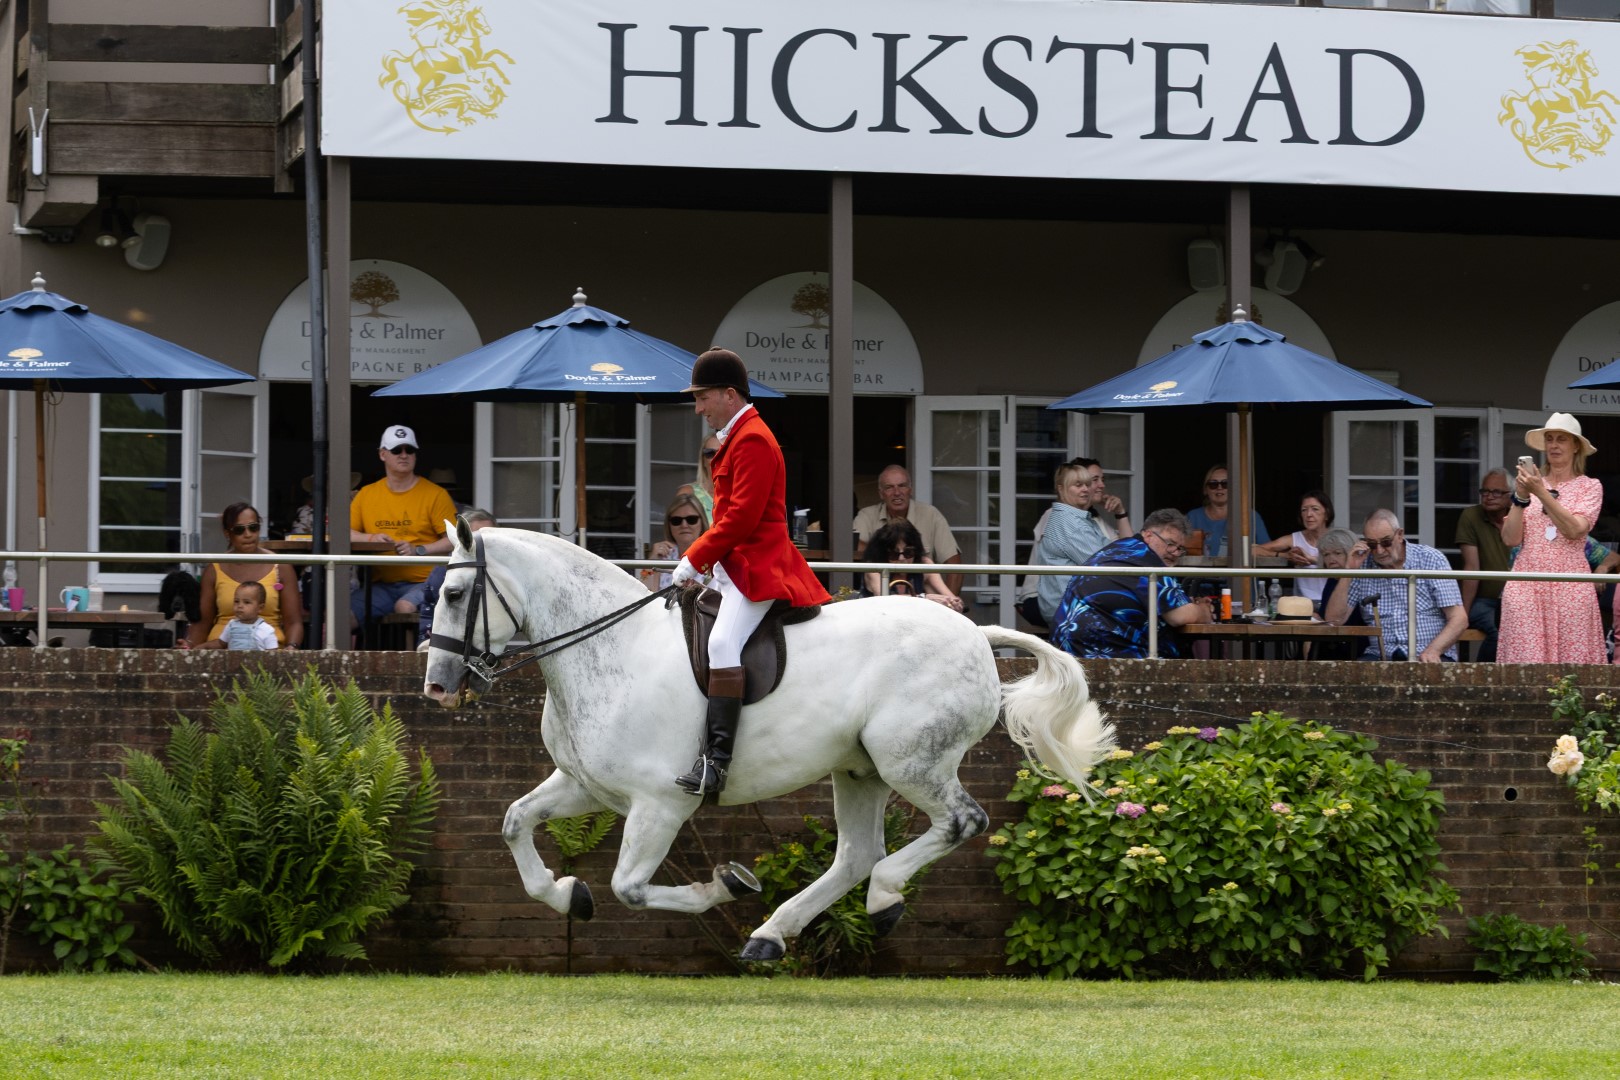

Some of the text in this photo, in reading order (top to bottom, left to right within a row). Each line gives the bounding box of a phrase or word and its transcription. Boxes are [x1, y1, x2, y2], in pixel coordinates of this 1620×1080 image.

[595, 22, 1425, 147] HICKSTEAD
[359, 322, 376, 339] &
[383, 322, 446, 341] Palmer
[745, 331, 796, 352] Doyle
[801, 333, 817, 350] &
[365, 347, 426, 355] MANAGEMENT
[770, 356, 804, 364] WEALTH
[564, 374, 599, 382] Doyle
[853, 373, 883, 385] BAR
